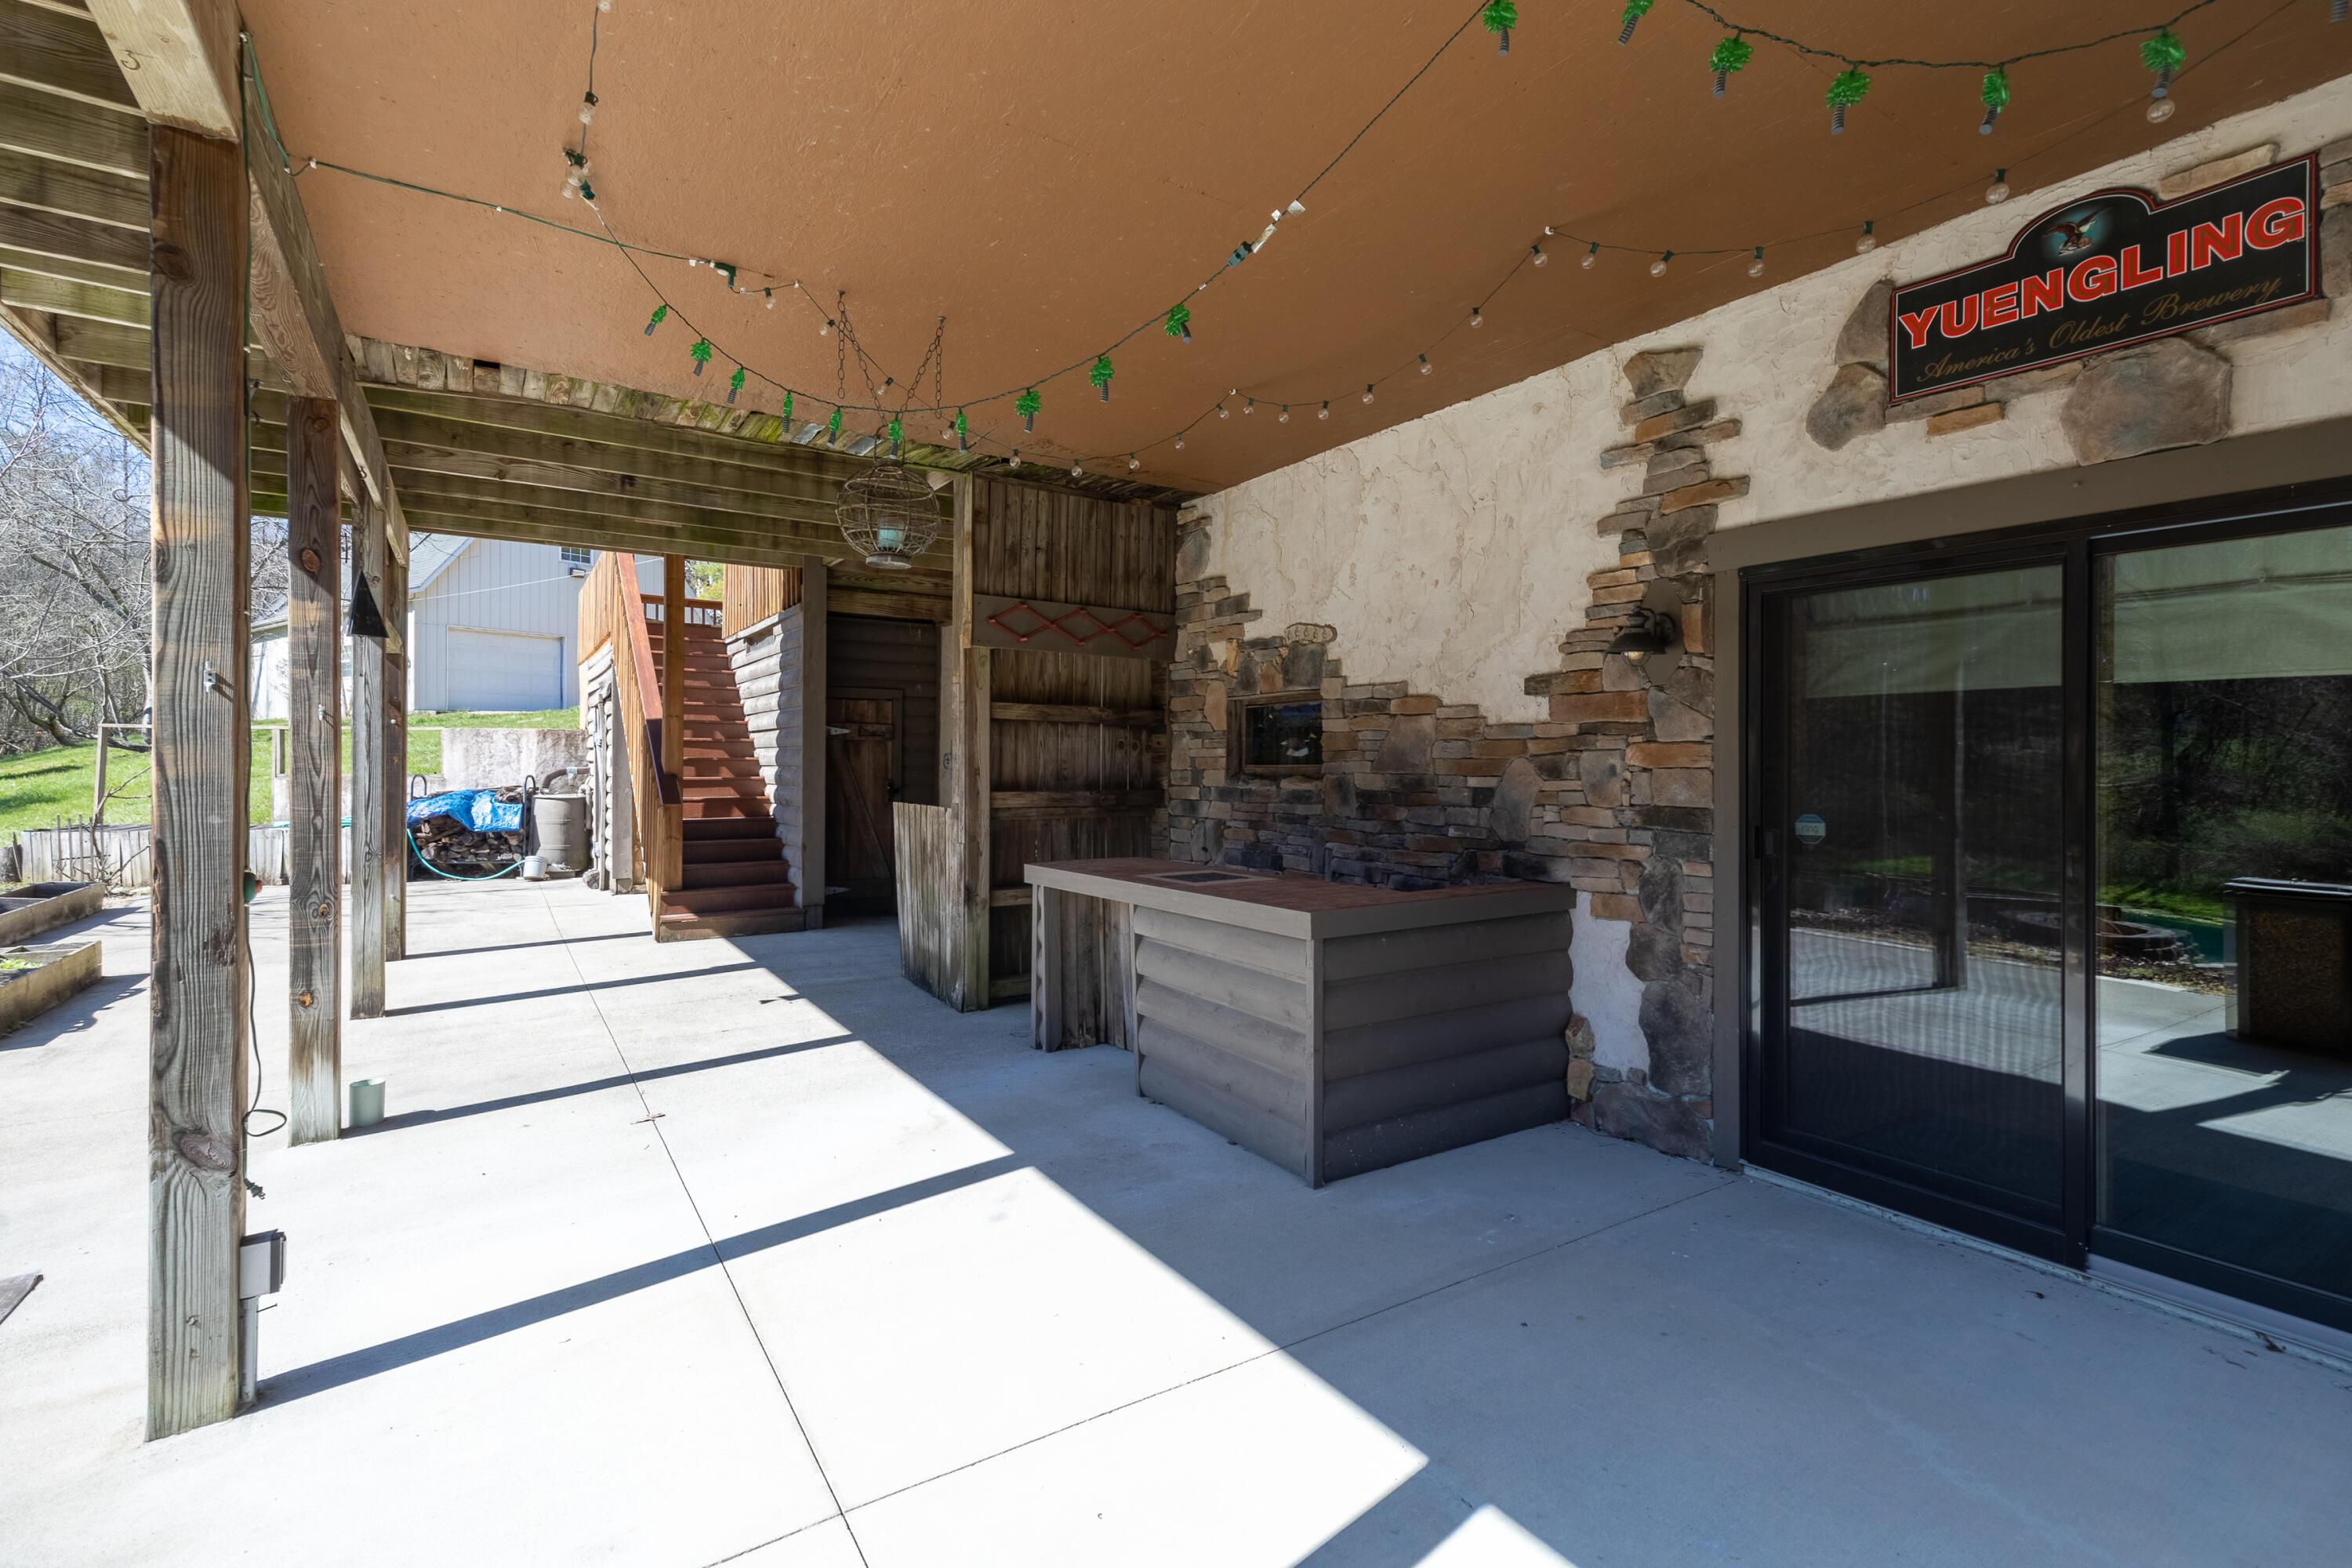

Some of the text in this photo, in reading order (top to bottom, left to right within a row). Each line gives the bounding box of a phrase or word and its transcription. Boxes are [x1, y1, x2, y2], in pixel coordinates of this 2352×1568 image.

[1899, 196, 2306, 350] YUENGLING
[1916, 338, 2037, 382] America's
[2049, 313, 2131, 349] Oldest
[1802, 824, 1819, 835] ring
